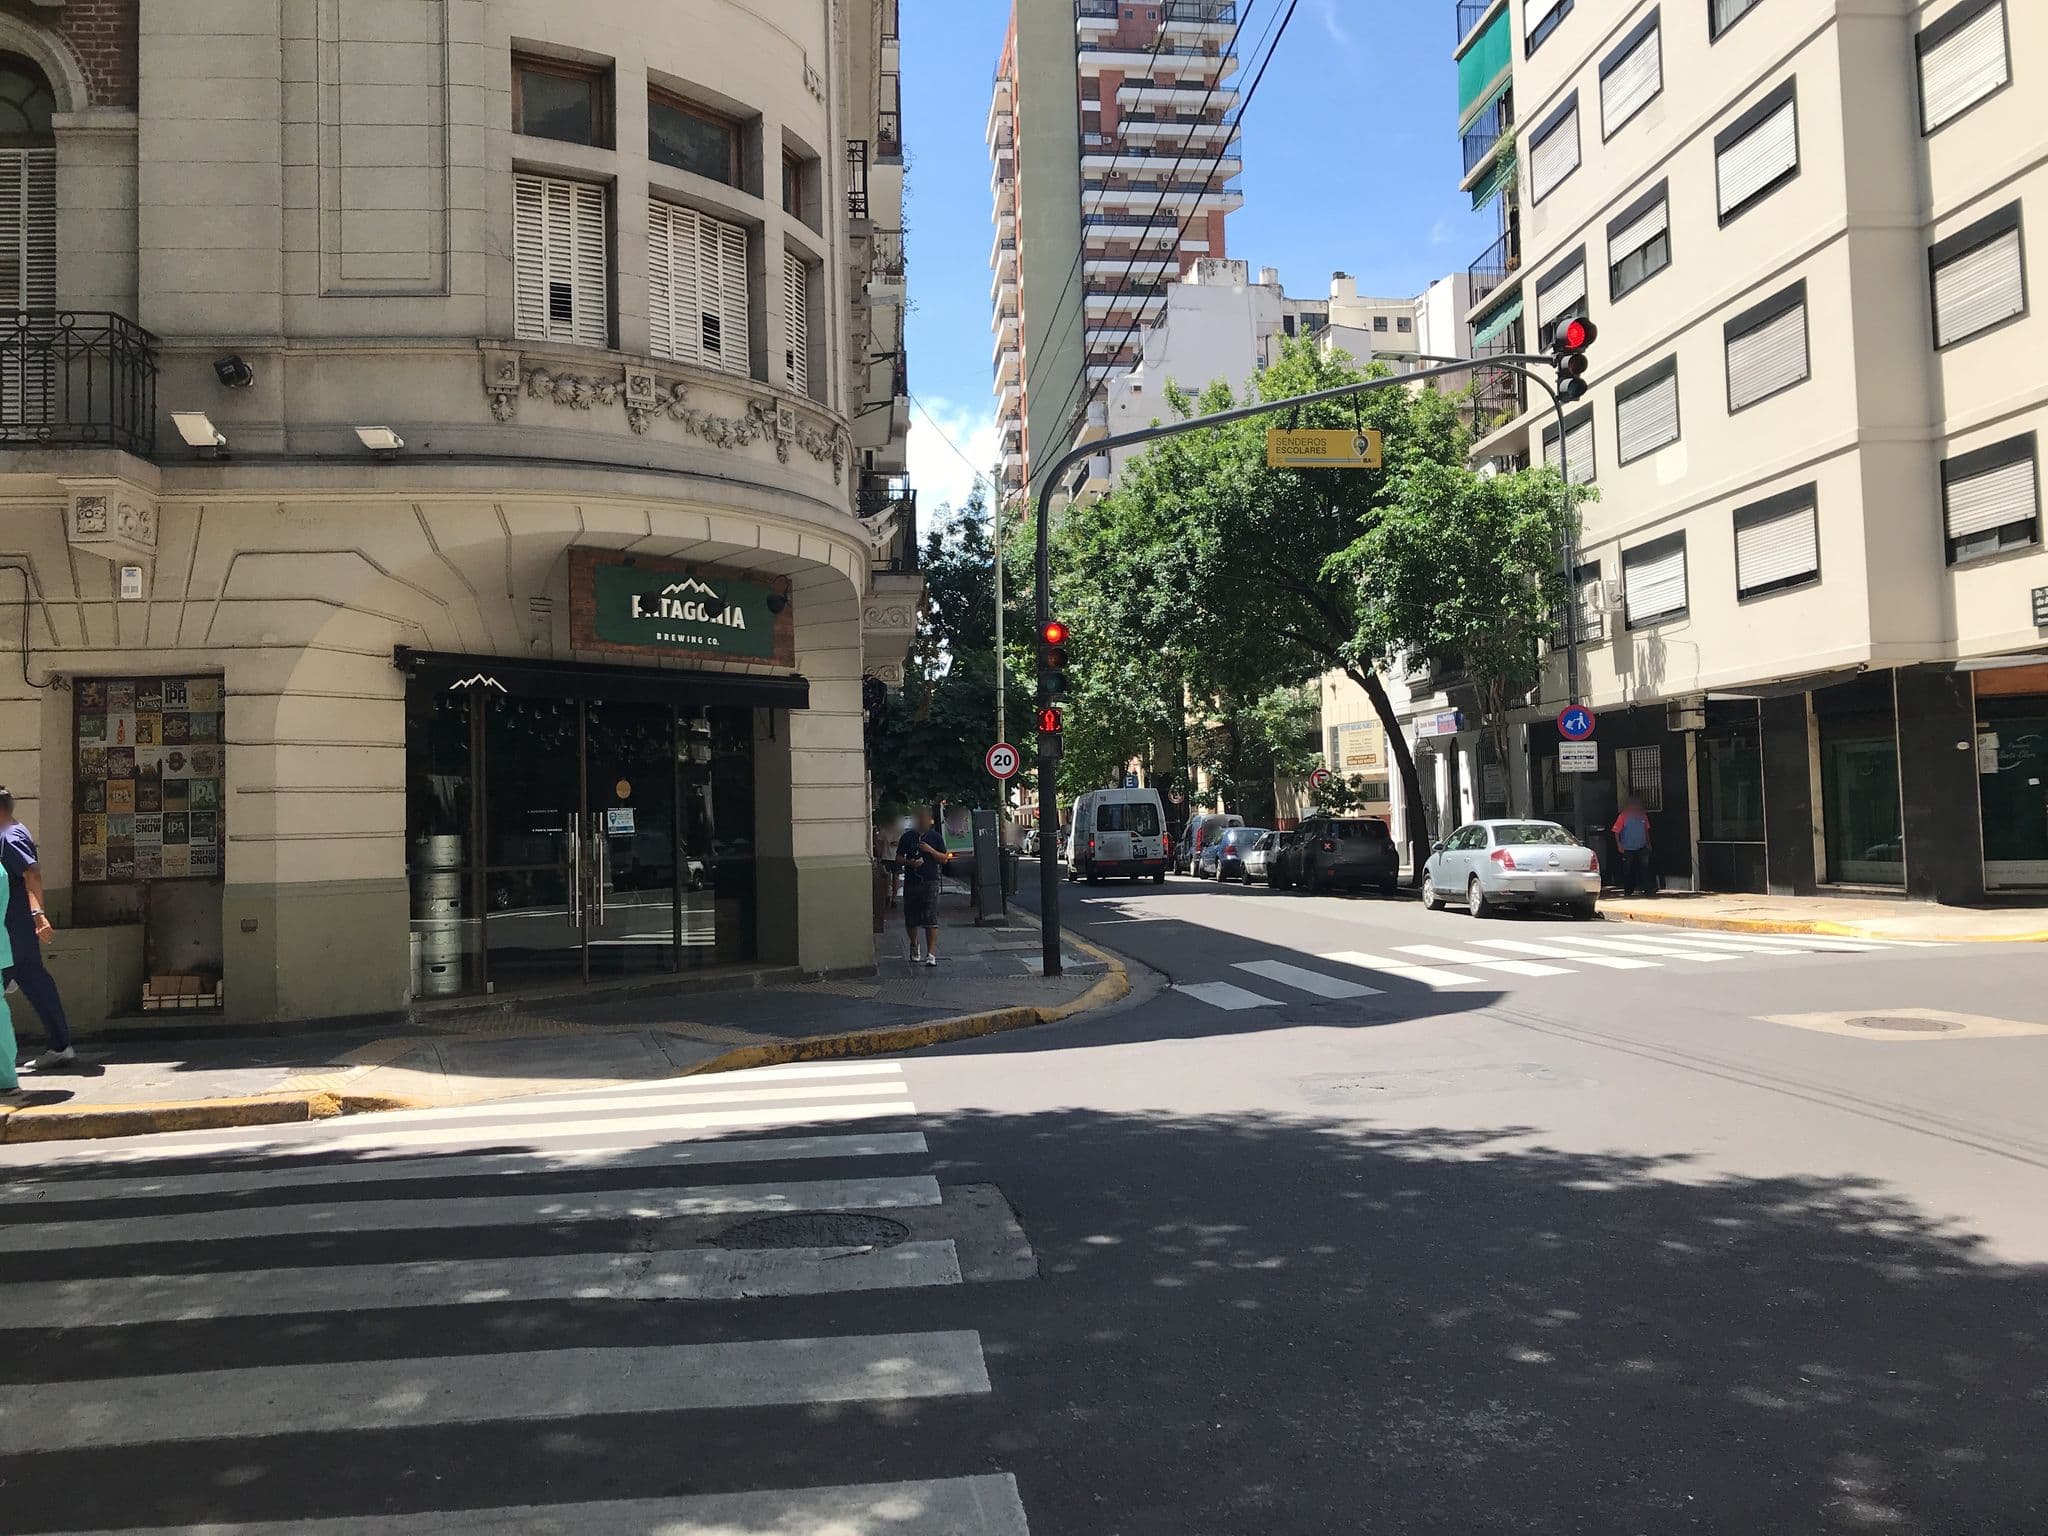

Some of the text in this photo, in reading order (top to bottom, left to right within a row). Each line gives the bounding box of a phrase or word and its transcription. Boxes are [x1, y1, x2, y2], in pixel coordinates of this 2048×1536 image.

[1275, 437, 1327, 447] SENDEROS
[1275, 446, 1327, 455] ESCOLARES
[631, 594, 746, 630] PTAGOIA
[656, 631, 720, 646] BREWING CO.
[993, 754, 1012, 767] 20
[1125, 776, 1134, 787] E
[191, 783, 217, 803] IPA
[136, 824, 161, 833] SNOW
[167, 821, 185, 833] IPA
[191, 856, 216, 865] SNOW
